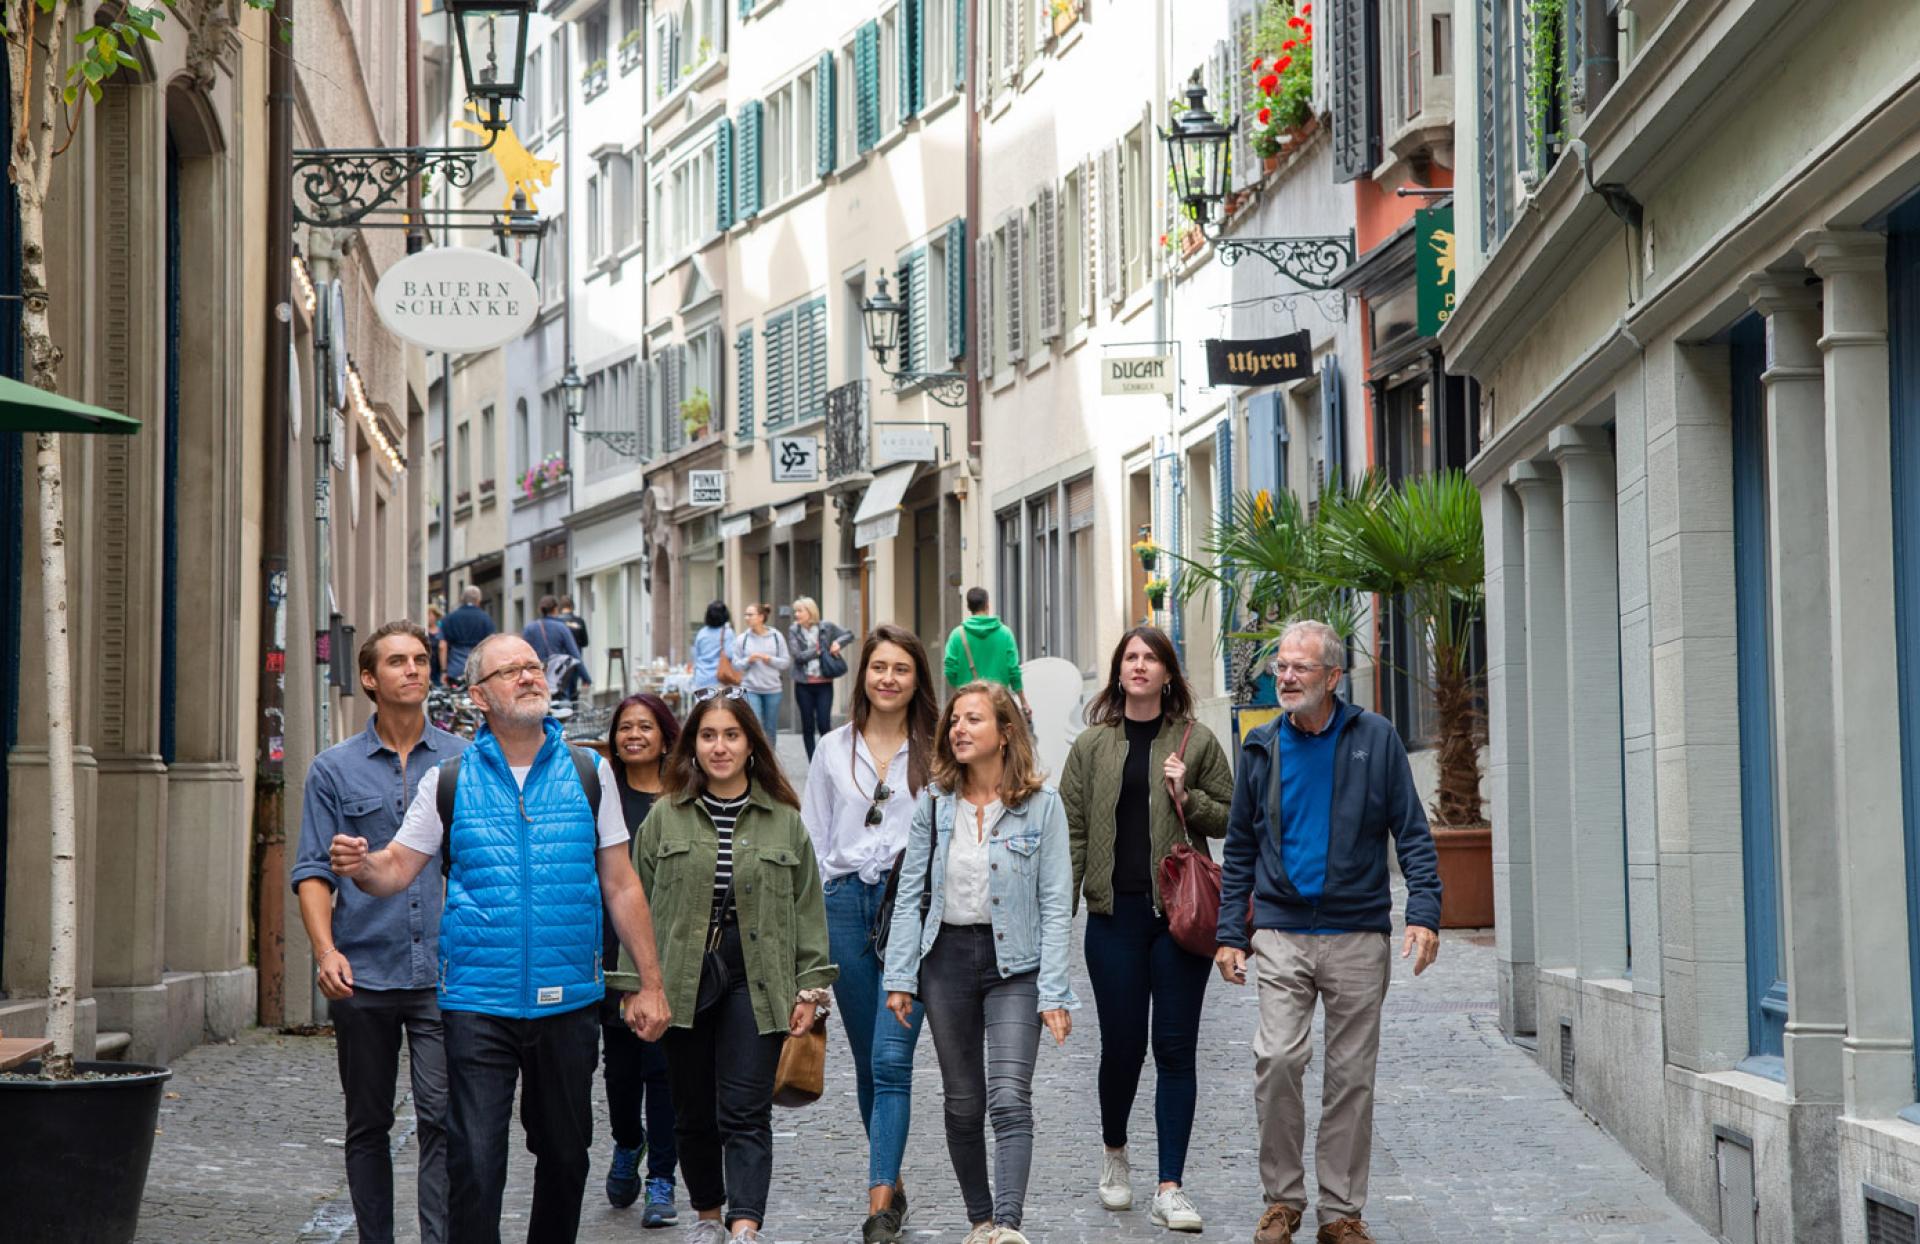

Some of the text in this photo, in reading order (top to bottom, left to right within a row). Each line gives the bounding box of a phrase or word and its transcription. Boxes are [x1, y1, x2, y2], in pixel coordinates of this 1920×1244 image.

[402, 281, 511, 297] BAUERN
[395, 296, 519, 316] SCHÄNKE
[1226, 350, 1297, 377] Uhren
